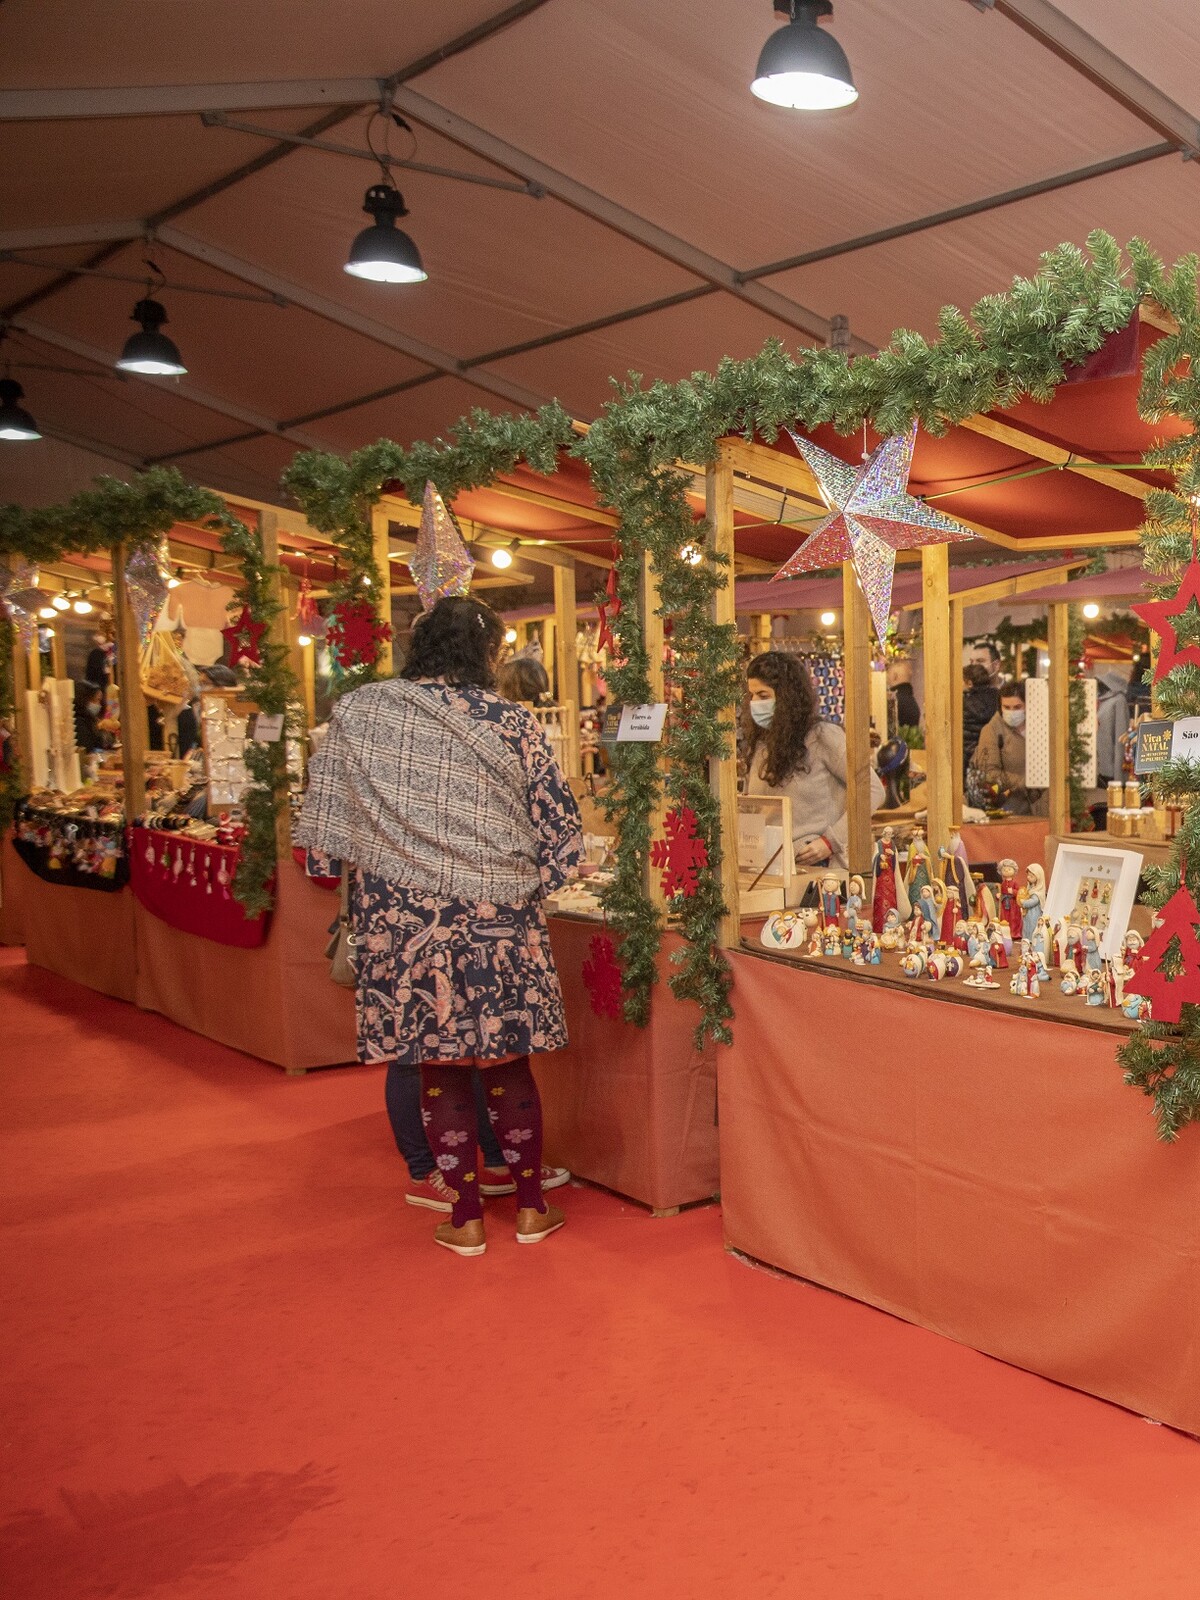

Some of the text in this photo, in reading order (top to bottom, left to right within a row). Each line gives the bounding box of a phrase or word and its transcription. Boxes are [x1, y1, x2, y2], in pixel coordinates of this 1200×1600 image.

[1143, 733, 1162, 743] Viva
[1182, 730, 1199, 740] São
[1142, 742, 1169, 752] NATAL
